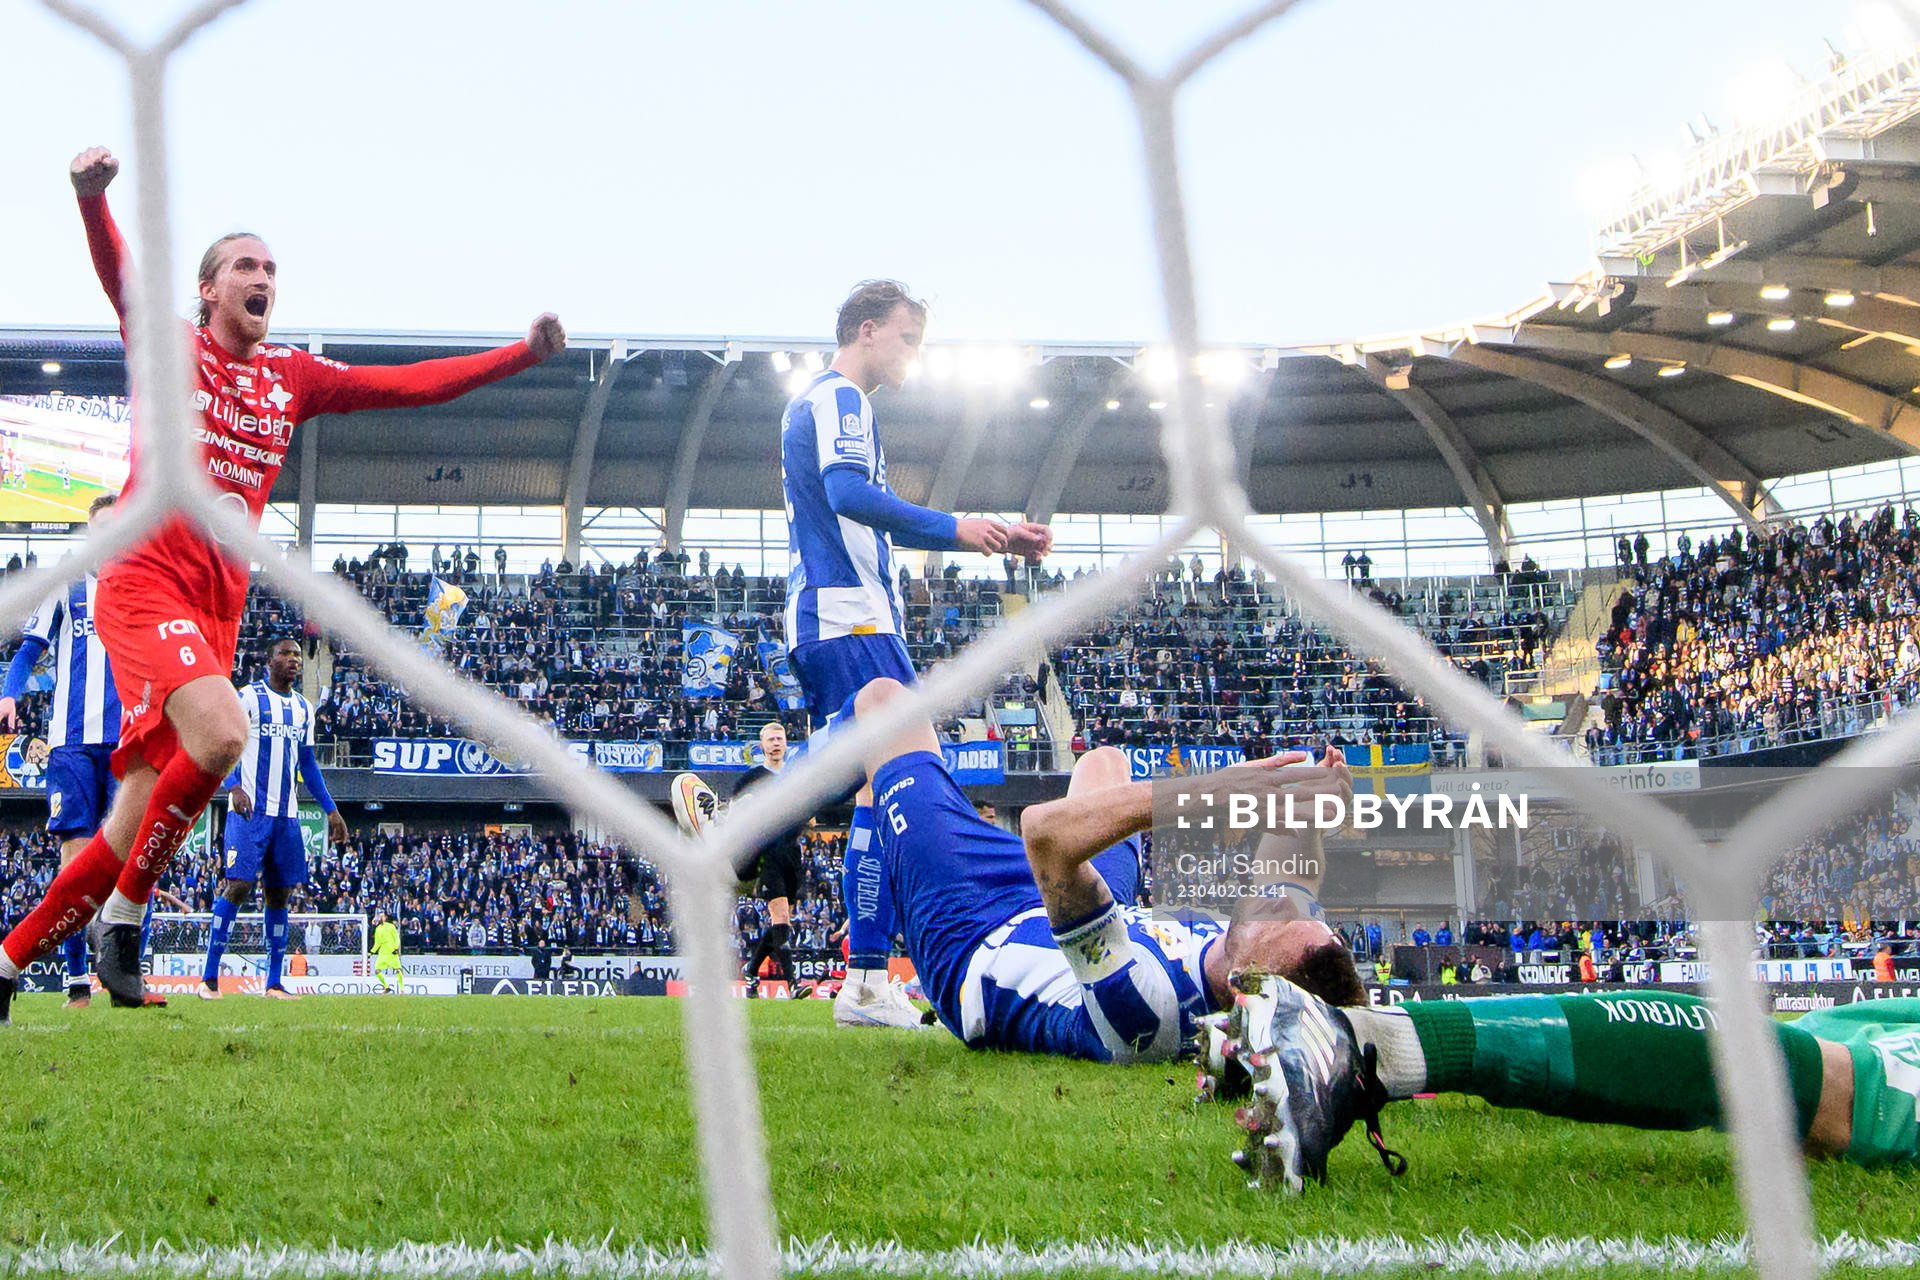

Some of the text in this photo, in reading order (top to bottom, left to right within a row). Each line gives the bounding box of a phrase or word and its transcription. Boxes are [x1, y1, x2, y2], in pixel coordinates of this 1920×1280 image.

[179, 646, 197, 666] 6
[597, 753, 644, 765] OSLO
[1369, 988, 1422, 1007] EDA
